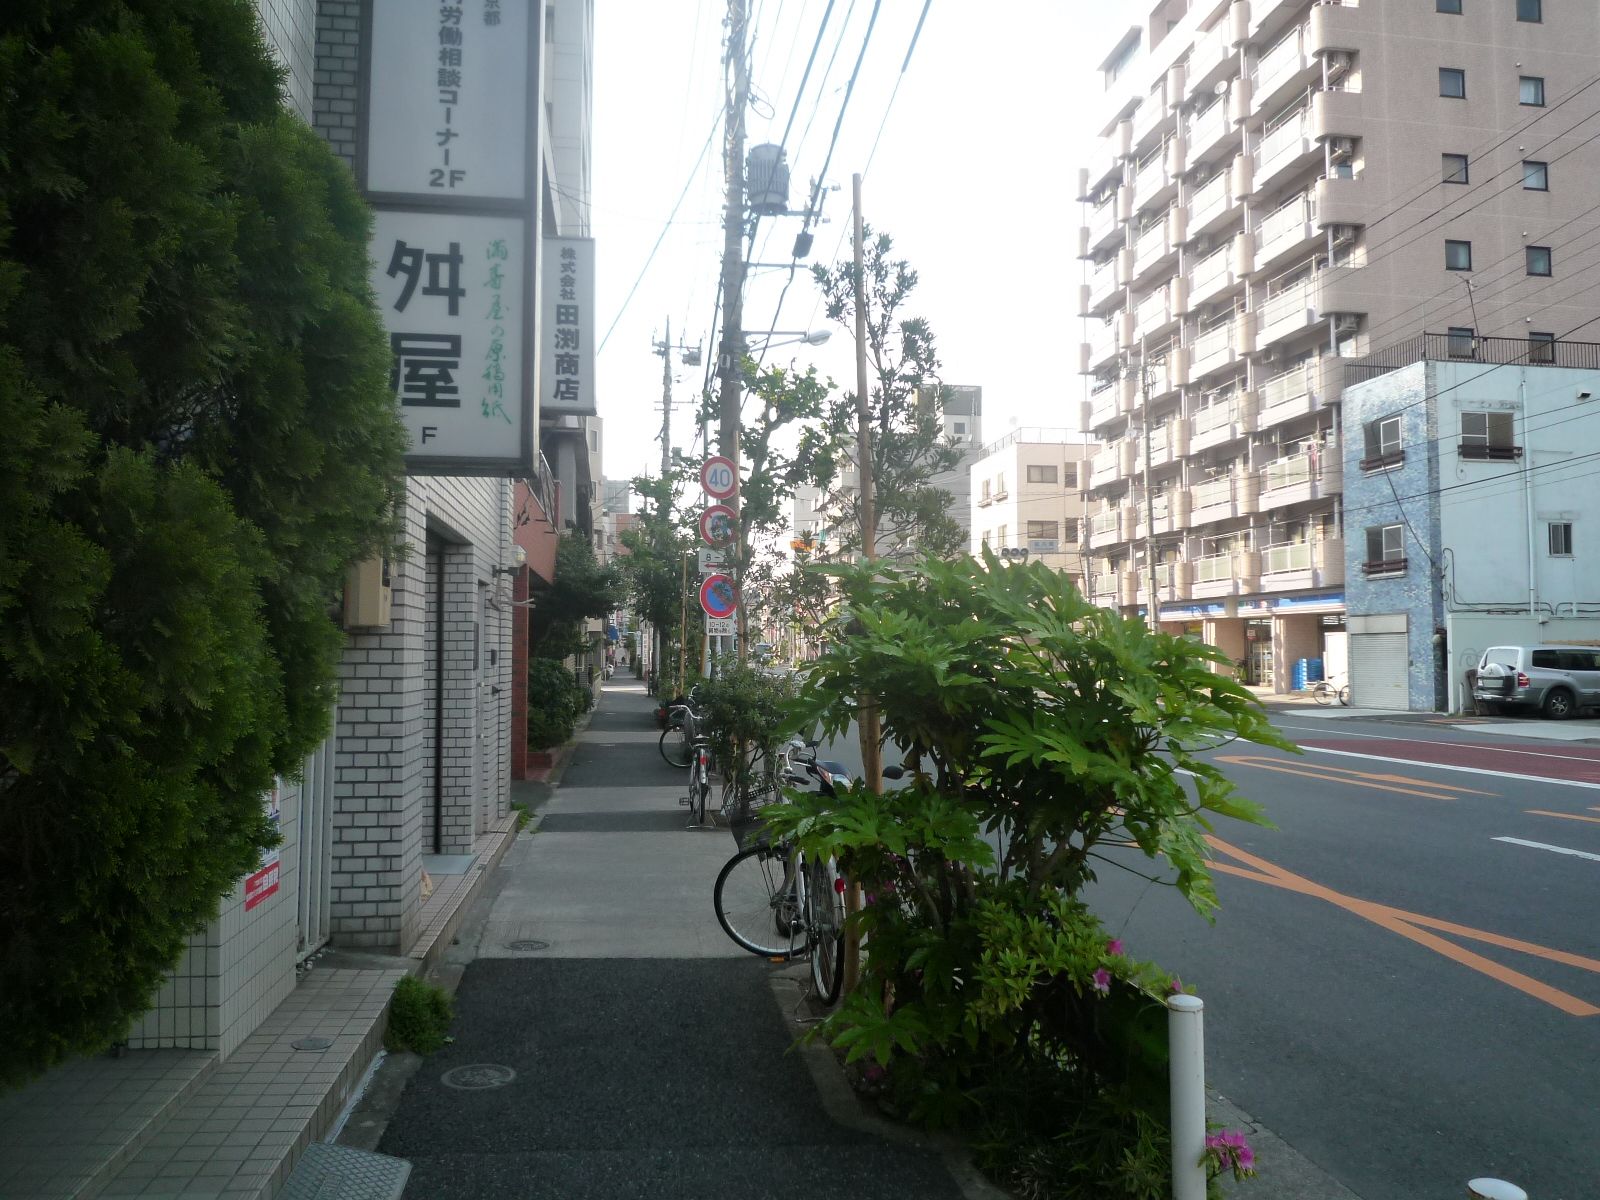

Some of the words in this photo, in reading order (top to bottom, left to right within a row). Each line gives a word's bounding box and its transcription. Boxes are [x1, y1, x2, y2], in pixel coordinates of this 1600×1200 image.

[436, 0, 464, 167] 労働相談コーナー
[429, 169, 466, 188] 2F
[709, 468, 730, 487] 40
